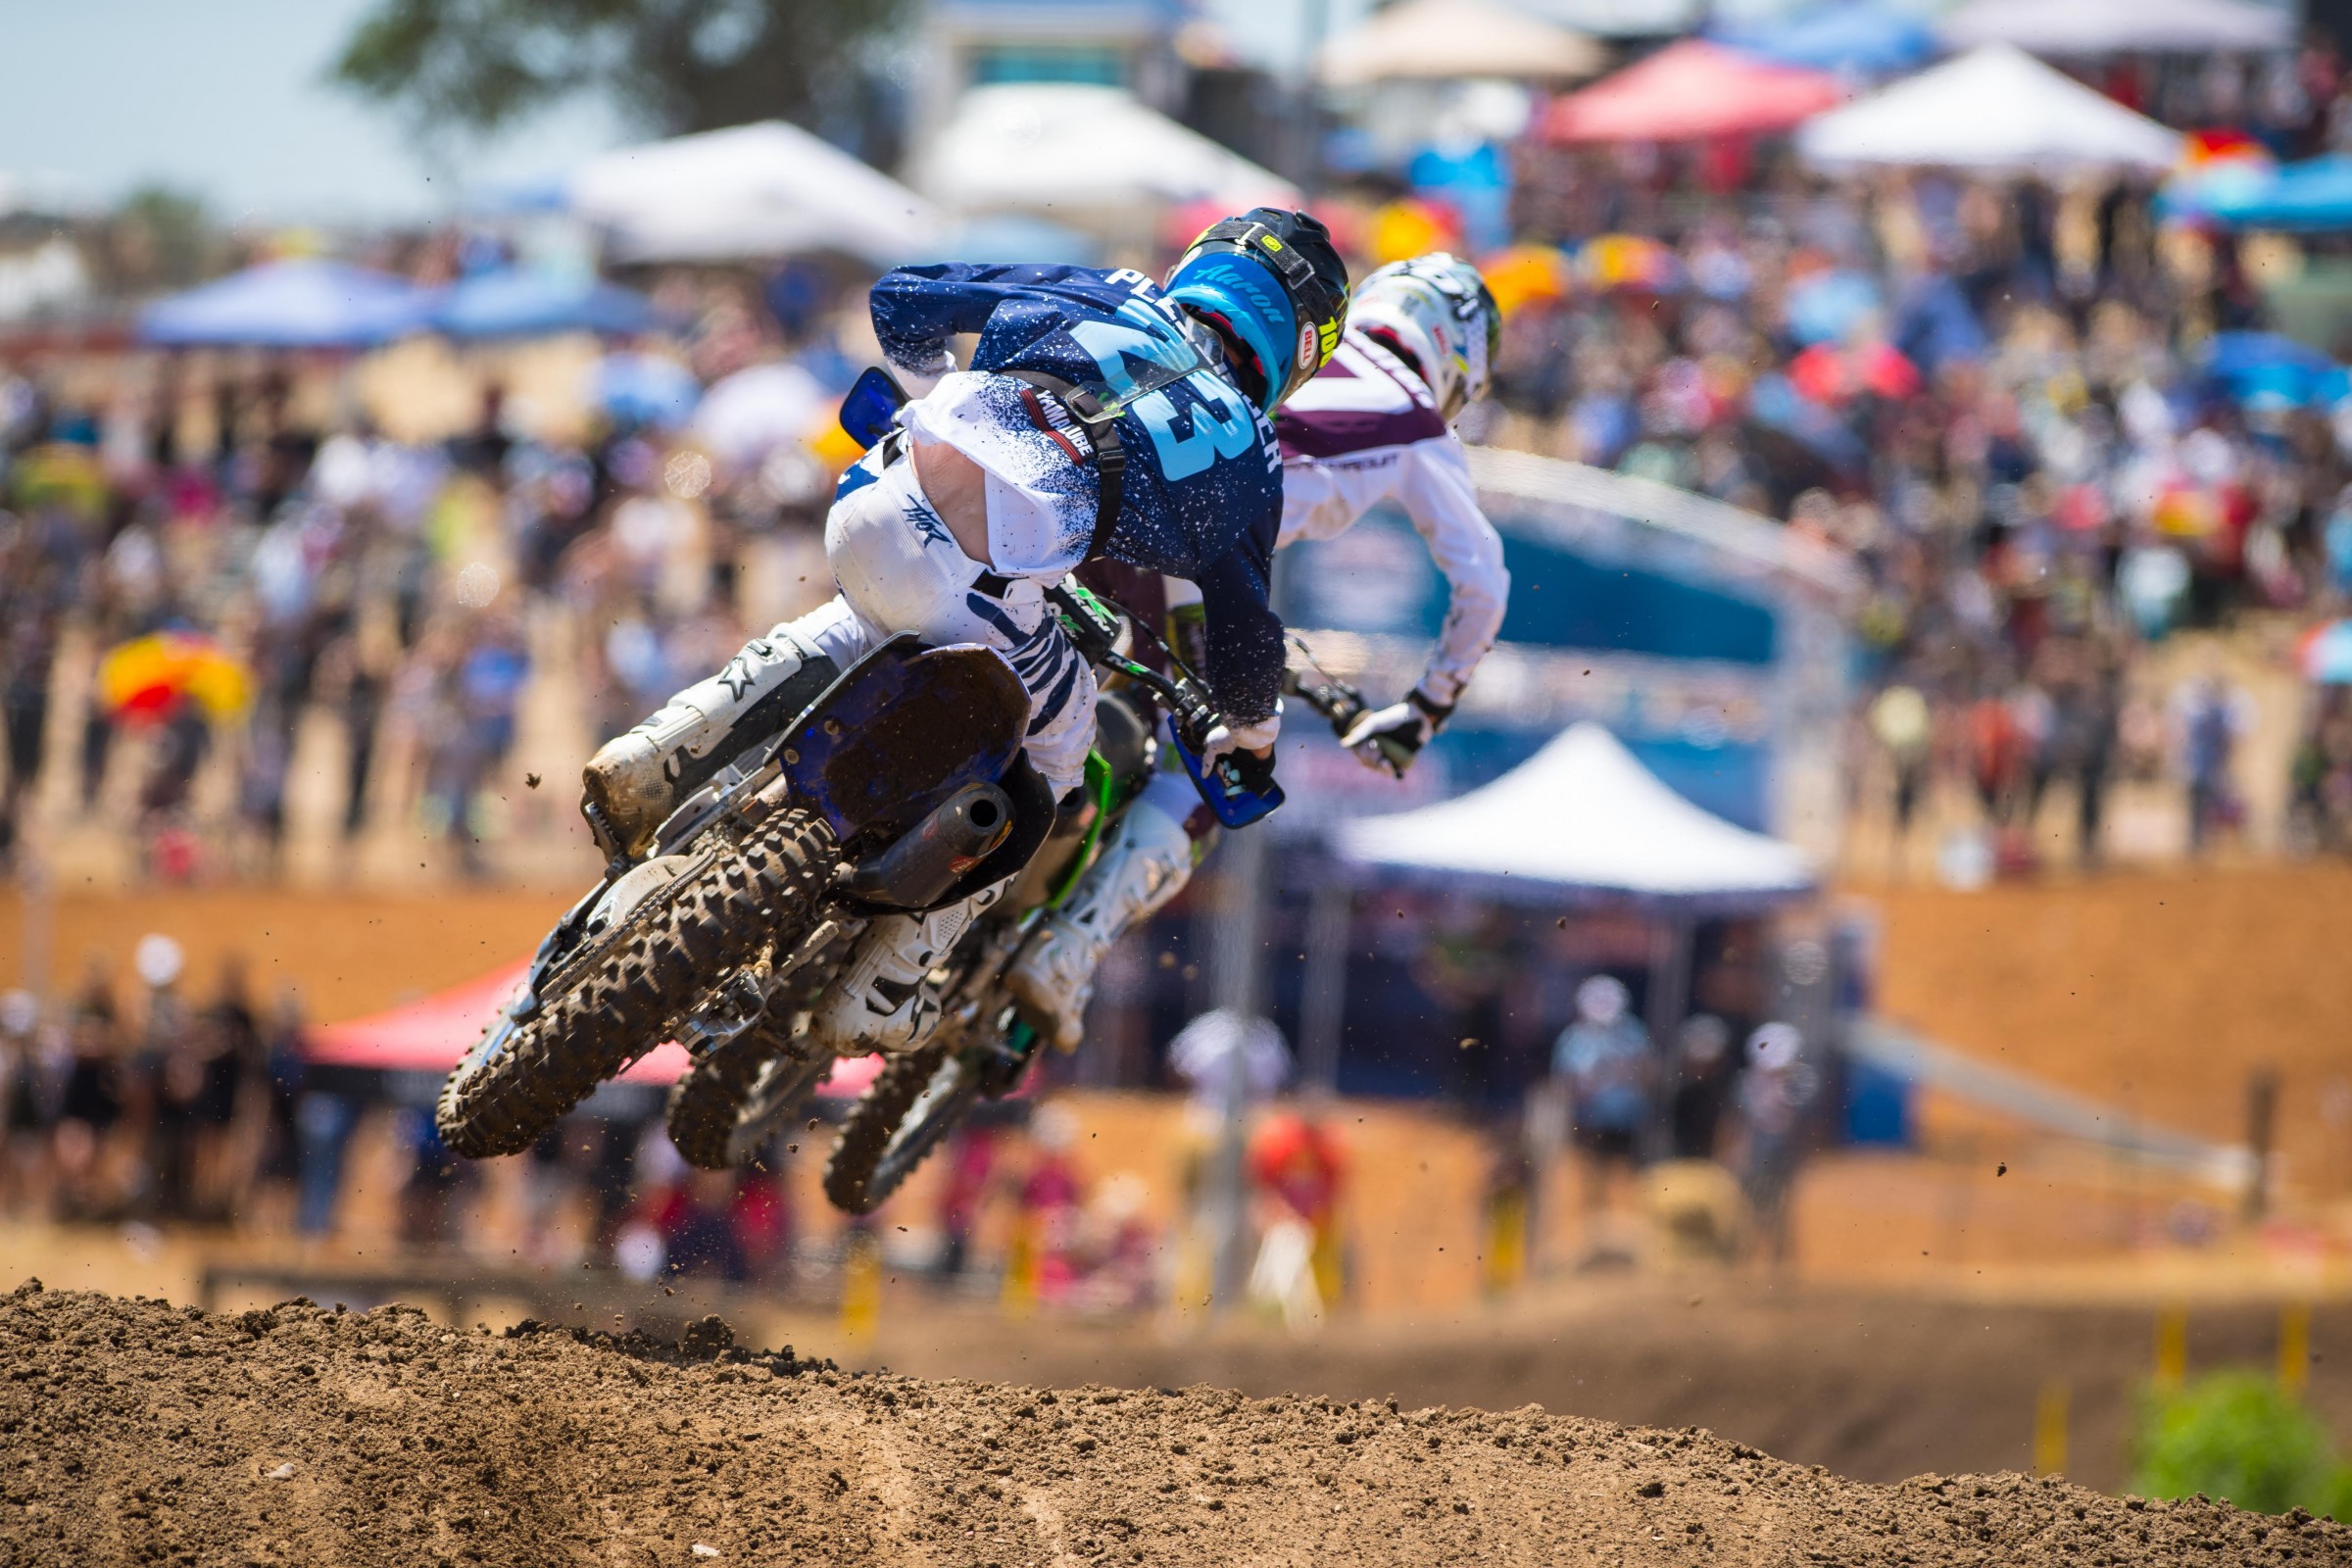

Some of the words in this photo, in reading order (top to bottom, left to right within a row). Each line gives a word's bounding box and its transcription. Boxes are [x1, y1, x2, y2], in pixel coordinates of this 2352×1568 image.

[1194, 264, 1286, 324] Aaron
[1301, 328, 1314, 363] BELL
[1068, 298, 1255, 481] 23
[1036, 390, 1094, 457] YAMALUBE
